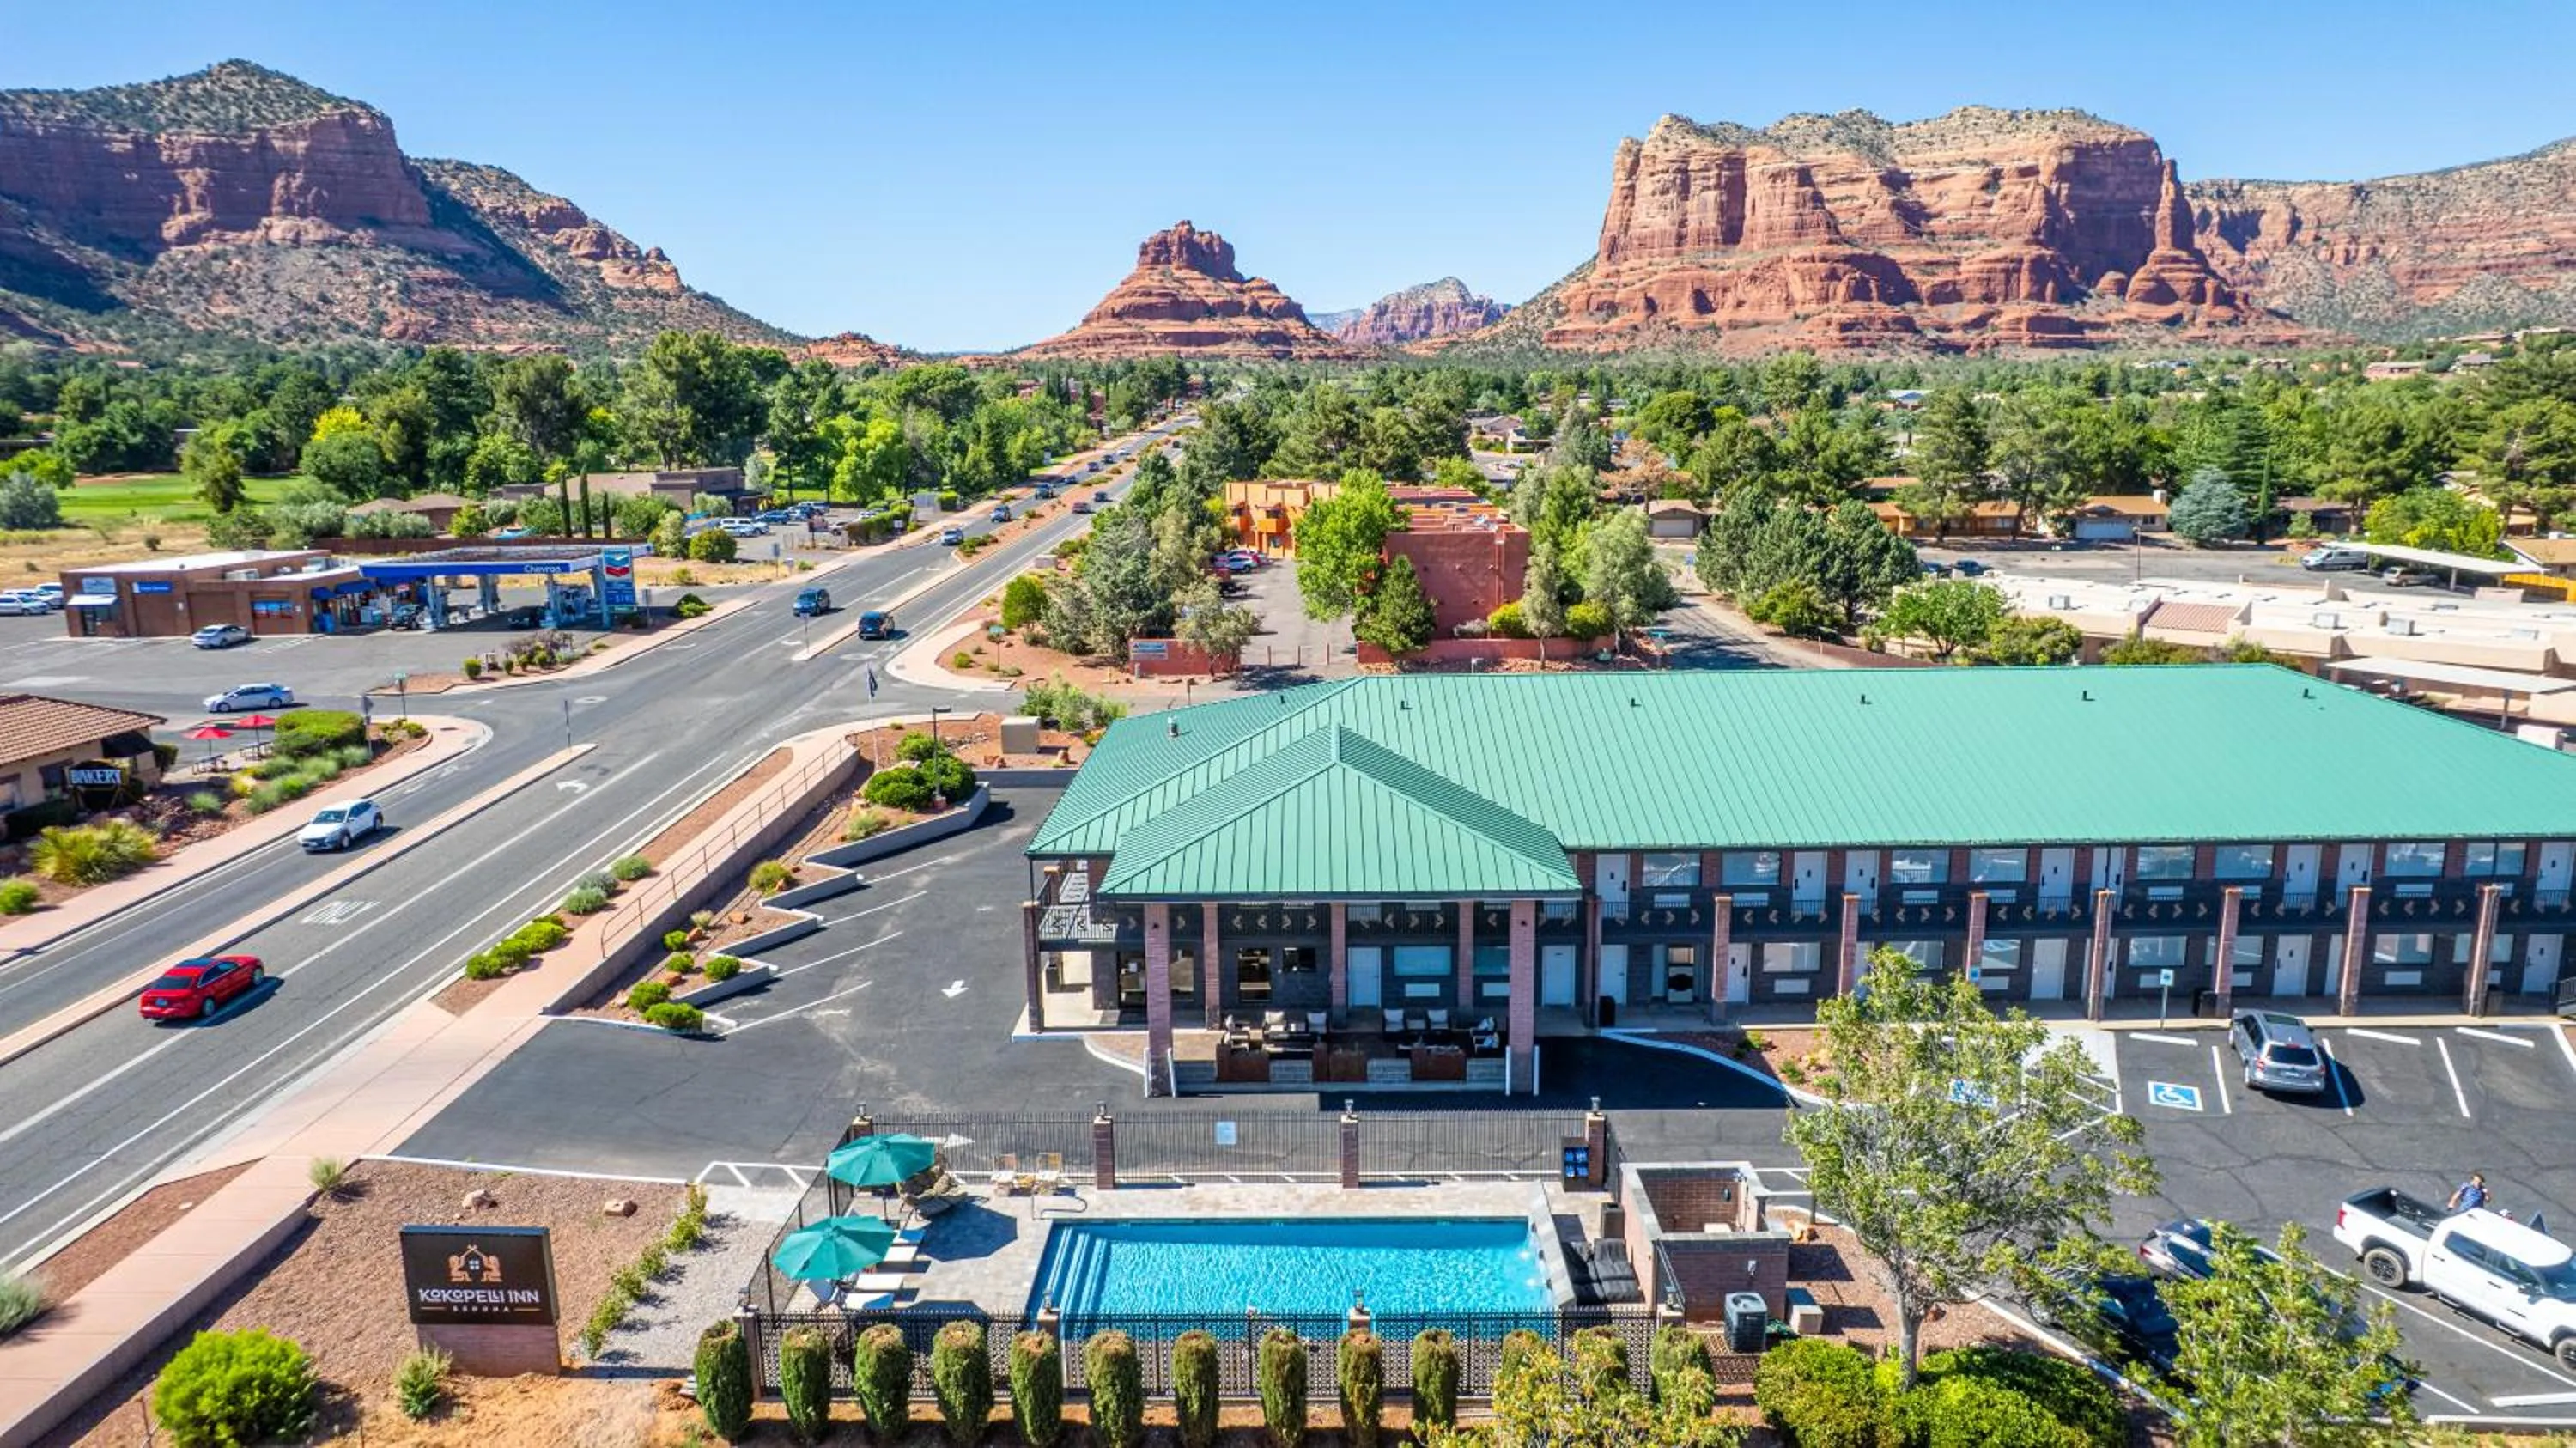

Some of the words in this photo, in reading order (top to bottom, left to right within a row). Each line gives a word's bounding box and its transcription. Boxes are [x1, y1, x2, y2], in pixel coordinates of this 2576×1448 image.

[524, 564, 561, 573] Chevron
[71, 769, 121, 783] BAKERY
[418, 1288, 506, 1304] KOKOPELLI
[509, 1289, 539, 1303] INN
